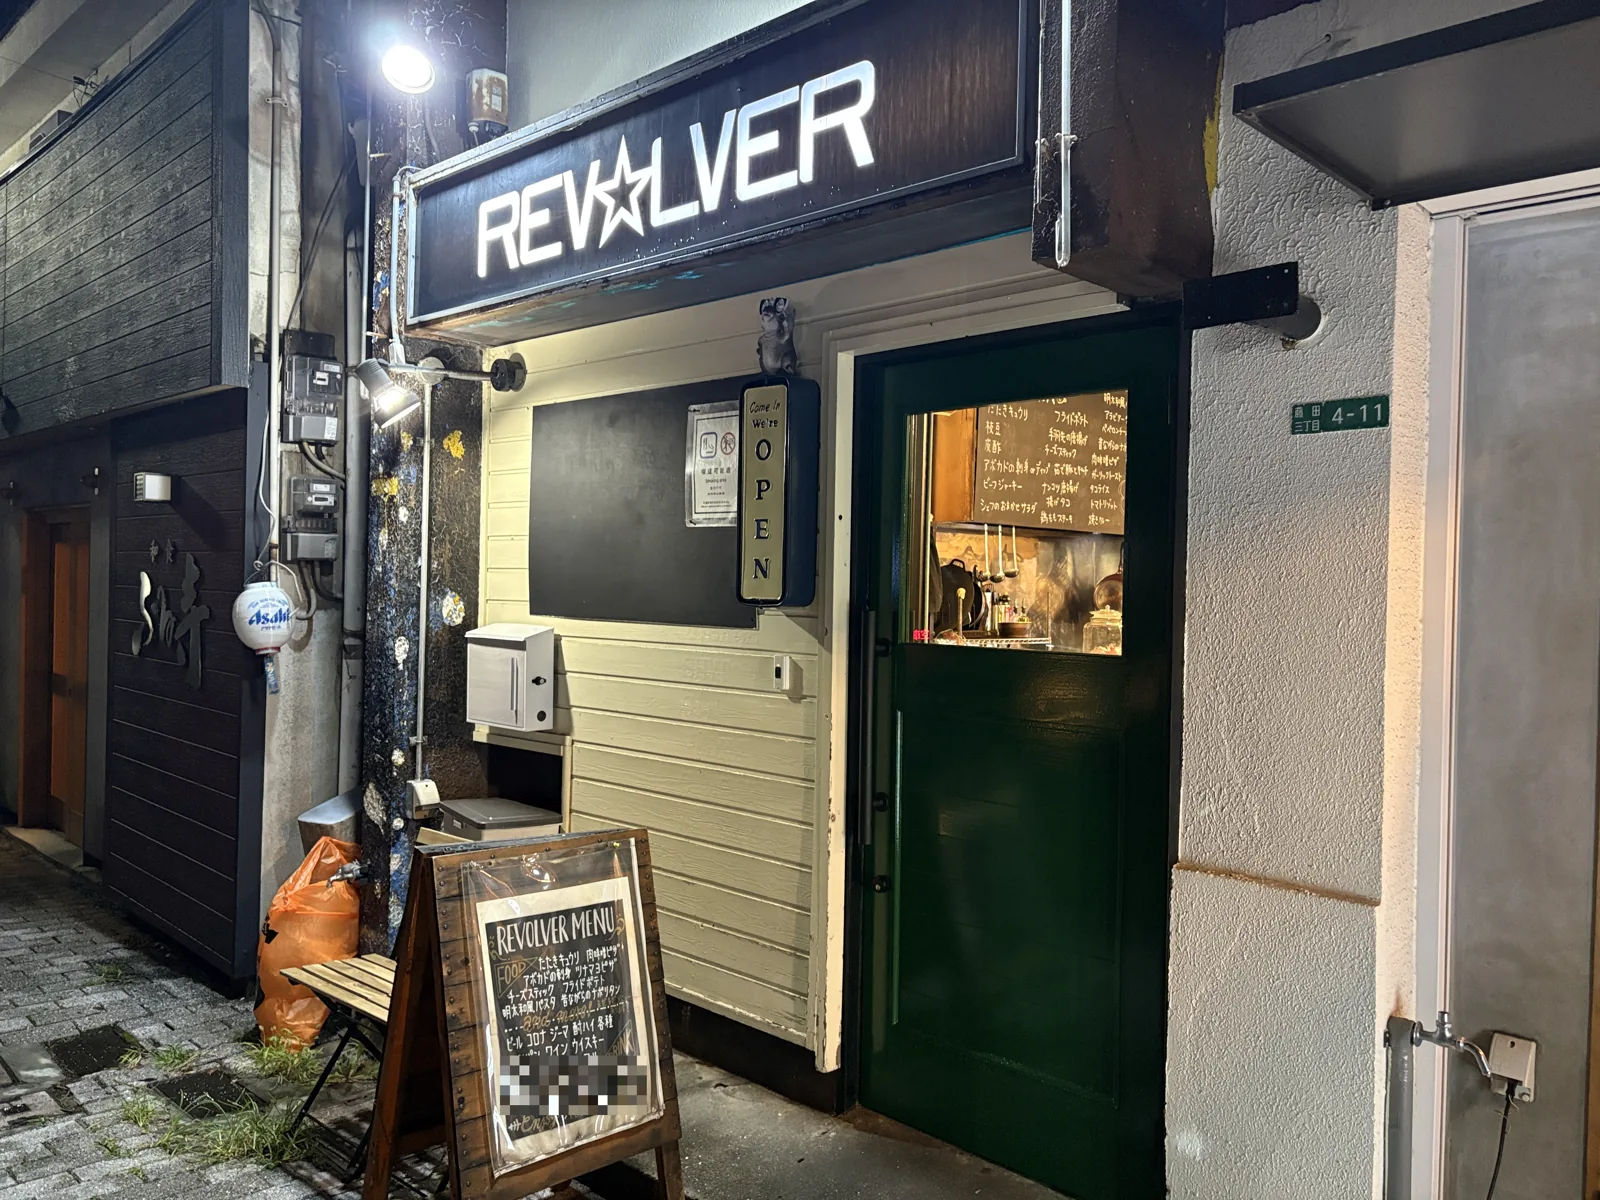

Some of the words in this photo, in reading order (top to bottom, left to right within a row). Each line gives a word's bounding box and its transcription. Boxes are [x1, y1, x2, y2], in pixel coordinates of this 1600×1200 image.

[750, 401, 770, 413] Come
[773, 399, 781, 411] In
[1331, 403, 1381, 425] 4-11
[752, 418, 779, 428] We're
[985, 420, 1001, 436] 枝豆
[1054, 409, 1088, 427] フライドポテト
[1294, 419, 1320, 432] 三丁目
[1048, 427, 1089, 447] 手羽先の唐揚げ
[1045, 444, 1077, 459] チーズスティック
[983, 476, 1023, 492] ビーフジャーキー
[1042, 479, 1080, 496] ナンコツ唐揚げ
[1089, 484, 1111, 495] タコライス
[753, 438, 772, 579] OPEN
[980, 498, 1038, 515] シェフのおまかせサラダ
[1090, 497, 1118, 511] トマトリゾット
[248, 607, 290, 628] Asahi
[496, 914, 569, 956] REVOLVER
[571, 906, 615, 940] MENU
[538, 950, 580, 971] たたきキュウリ
[586, 943, 621, 962] 肉味噌ピザ
[497, 961, 526, 993] FOOD
[523, 968, 571, 990] アボカドの刺身
[575, 958, 618, 978] ツナマヨピザ
[507, 984, 554, 1004] チーズスティック
[563, 974, 605, 993] フライドポテト
[502, 997, 556, 1020] 明太和風パスタ
[560, 985, 621, 1007] 昔ながらのナポリタン
[506, 1036, 523, 1052] ビール
[526, 1029, 547, 1047] コロナ
[549, 1024, 569, 1042] ジーマ
[573, 1018, 595, 1035] 酎ハイ
[597, 1013, 614, 1031] 各種
[545, 1042, 568, 1056] ワイン
[571, 1034, 605, 1054] ウイスキー
